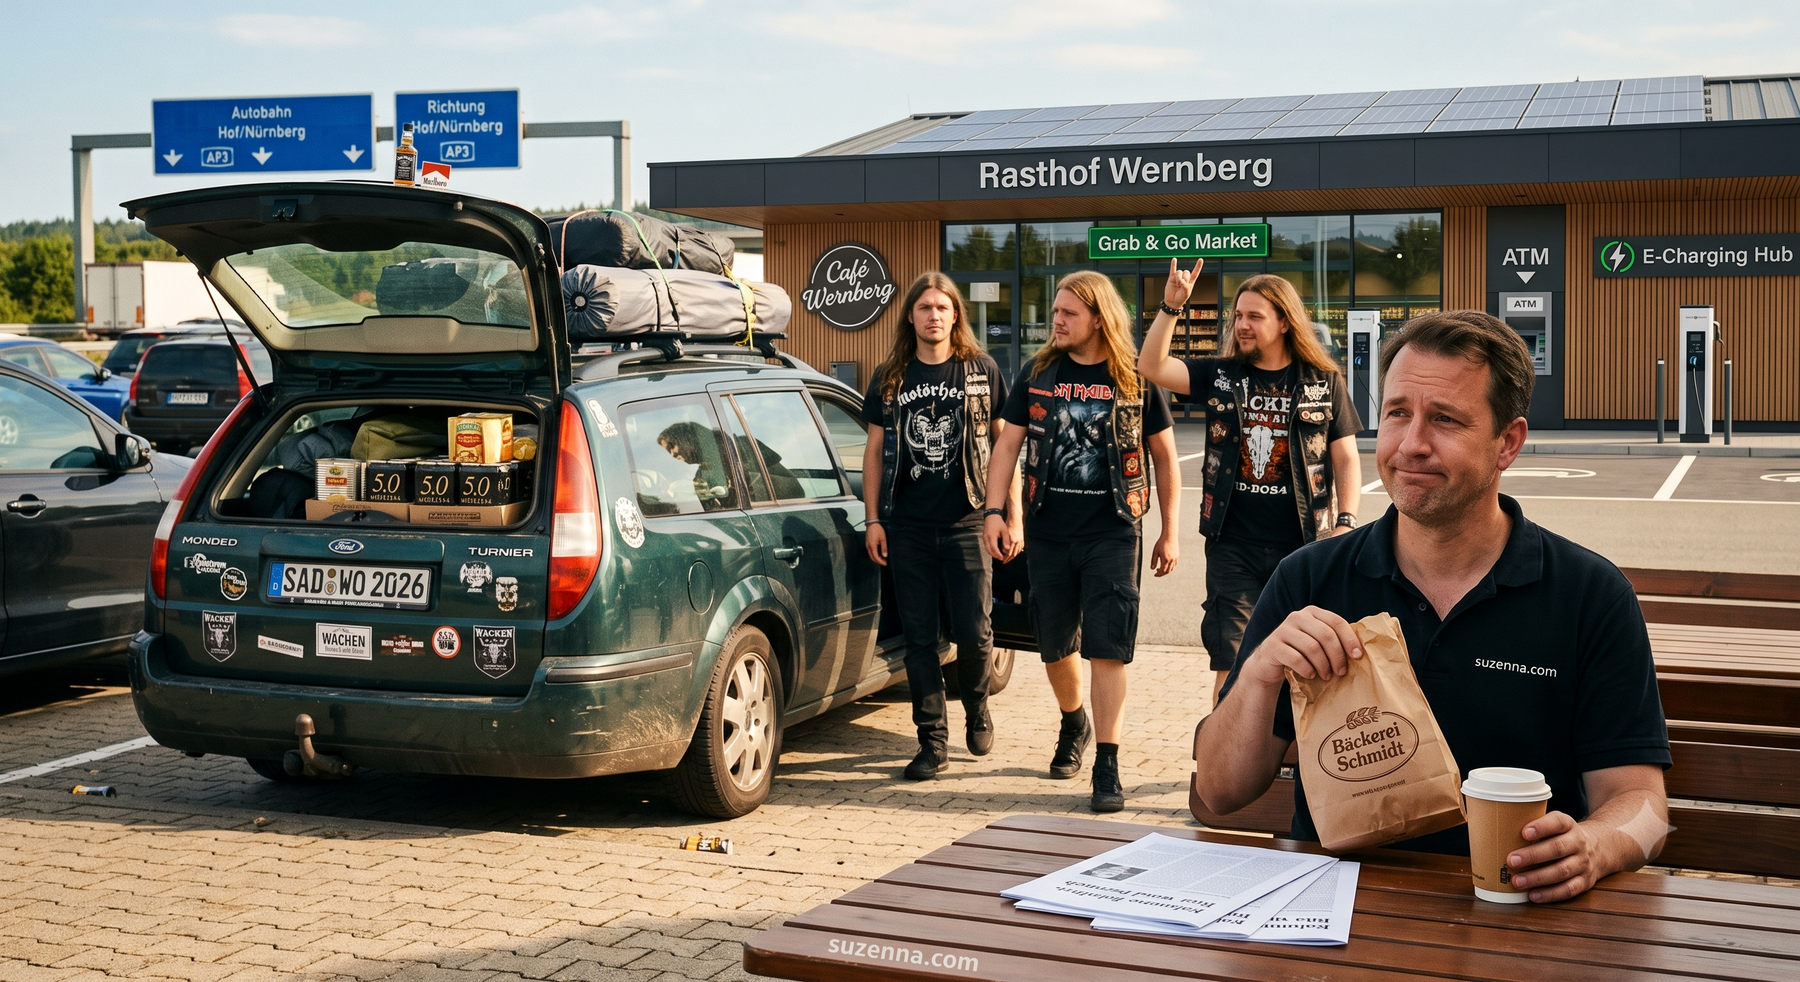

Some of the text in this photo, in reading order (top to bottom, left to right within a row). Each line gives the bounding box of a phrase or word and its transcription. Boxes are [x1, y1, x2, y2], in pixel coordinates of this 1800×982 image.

[231, 105, 292, 120] Autobahn
[427, 99, 486, 116] Richtung
[218, 124, 306, 141] Hof/Nürnberg
[411, 119, 504, 137] Hof/Nürnberg
[206, 149, 230, 163] AP3
[444, 145, 469, 159] AP3
[979, 153, 1274, 190] Rasthof Wernberg
[1098, 232, 1257, 252] Grab & Go Market
[1502, 247, 1549, 266] ATM
[1643, 246, 1794, 268] E-Charging Hub
[826, 258, 870, 286] Café
[802, 281, 896, 311] Wernberg
[1514, 300, 1537, 309] ATM
[1073, 383, 1116, 402] MAID
[372, 473, 401, 493] 5.0
[420, 475, 450, 496] 5.0
[462, 476, 491, 497] 5.0
[468, 547, 534, 557] TURNIER
[272, 582, 279, 590] D
[283, 566, 425, 599] SAD WO 2026
[204, 613, 235, 625] WACKEN
[322, 632, 366, 648] WACHEN
[475, 627, 513, 639] WACKEN
[1475, 657, 1558, 679] suzenna.com
[1331, 721, 1402, 755] Bäckerei
[1336, 740, 1406, 772] Schmidt
